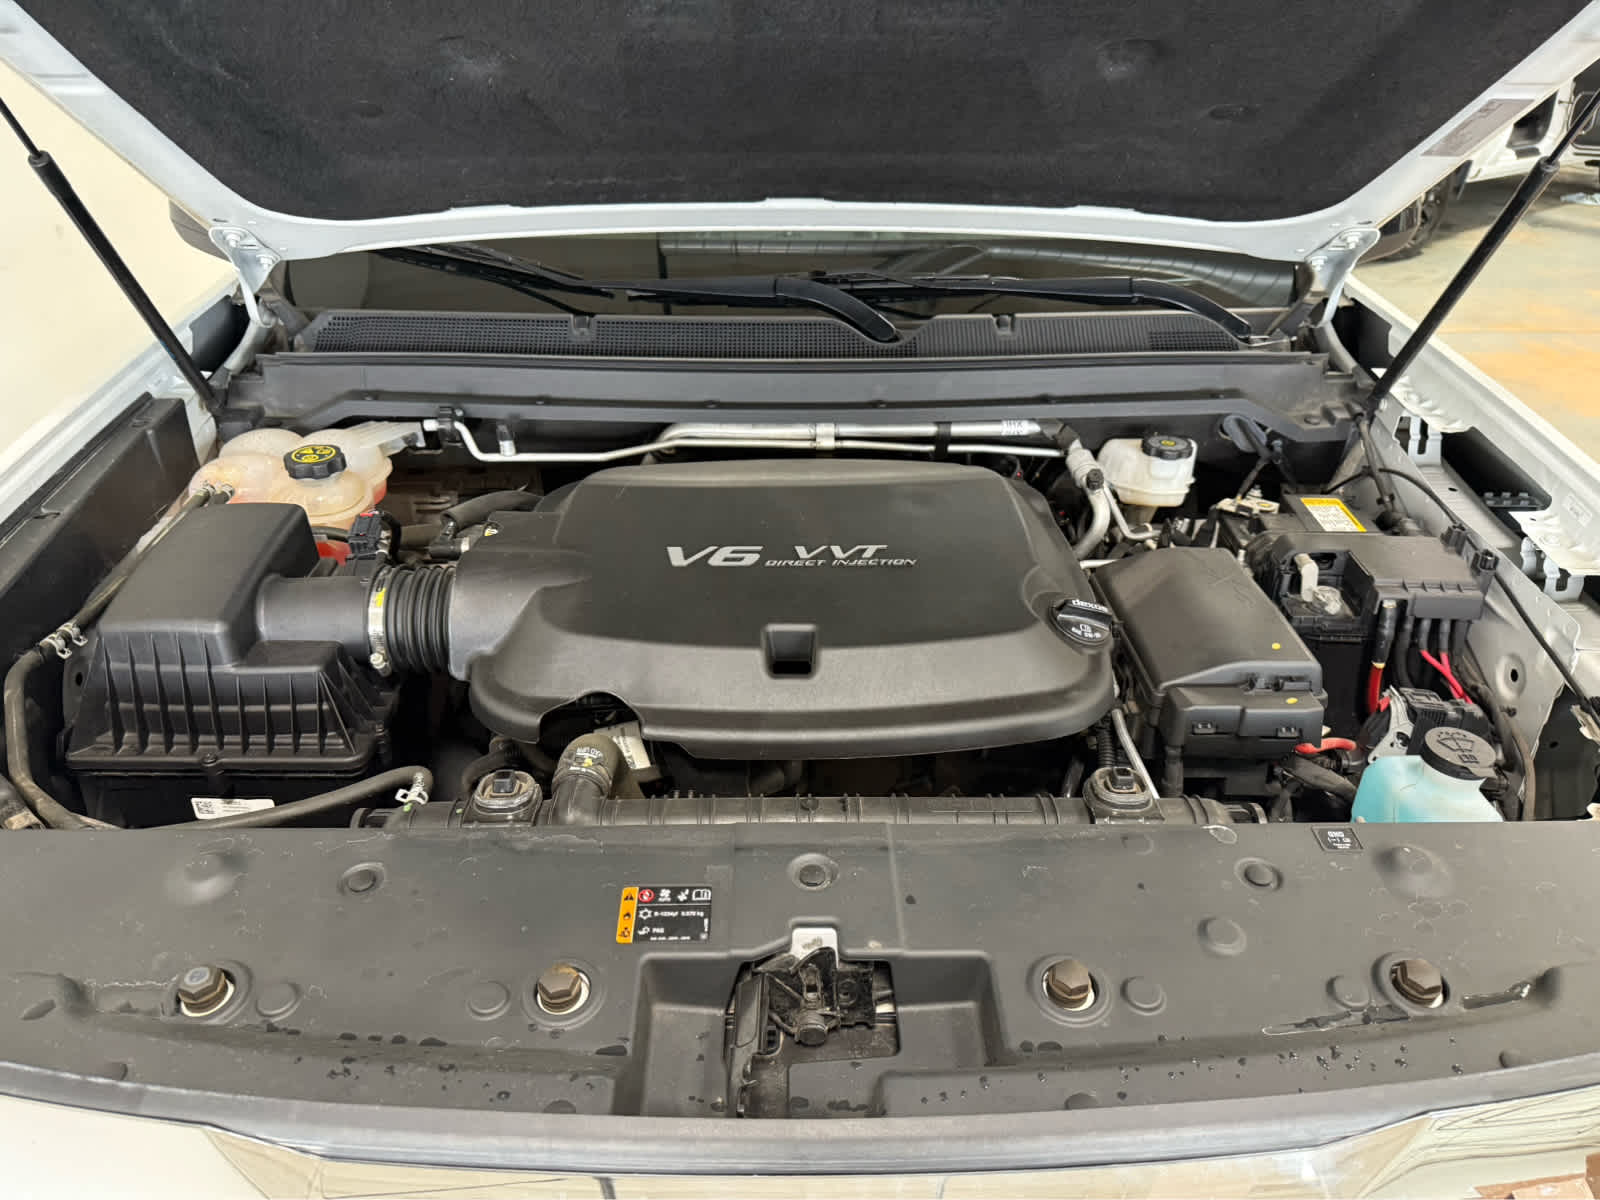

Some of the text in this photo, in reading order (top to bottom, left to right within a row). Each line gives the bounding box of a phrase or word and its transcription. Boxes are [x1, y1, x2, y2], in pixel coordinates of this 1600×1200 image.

[667, 546, 763, 567] V6
[794, 544, 889, 559] VVT
[764, 558, 917, 567] DIRECT INJECTION
